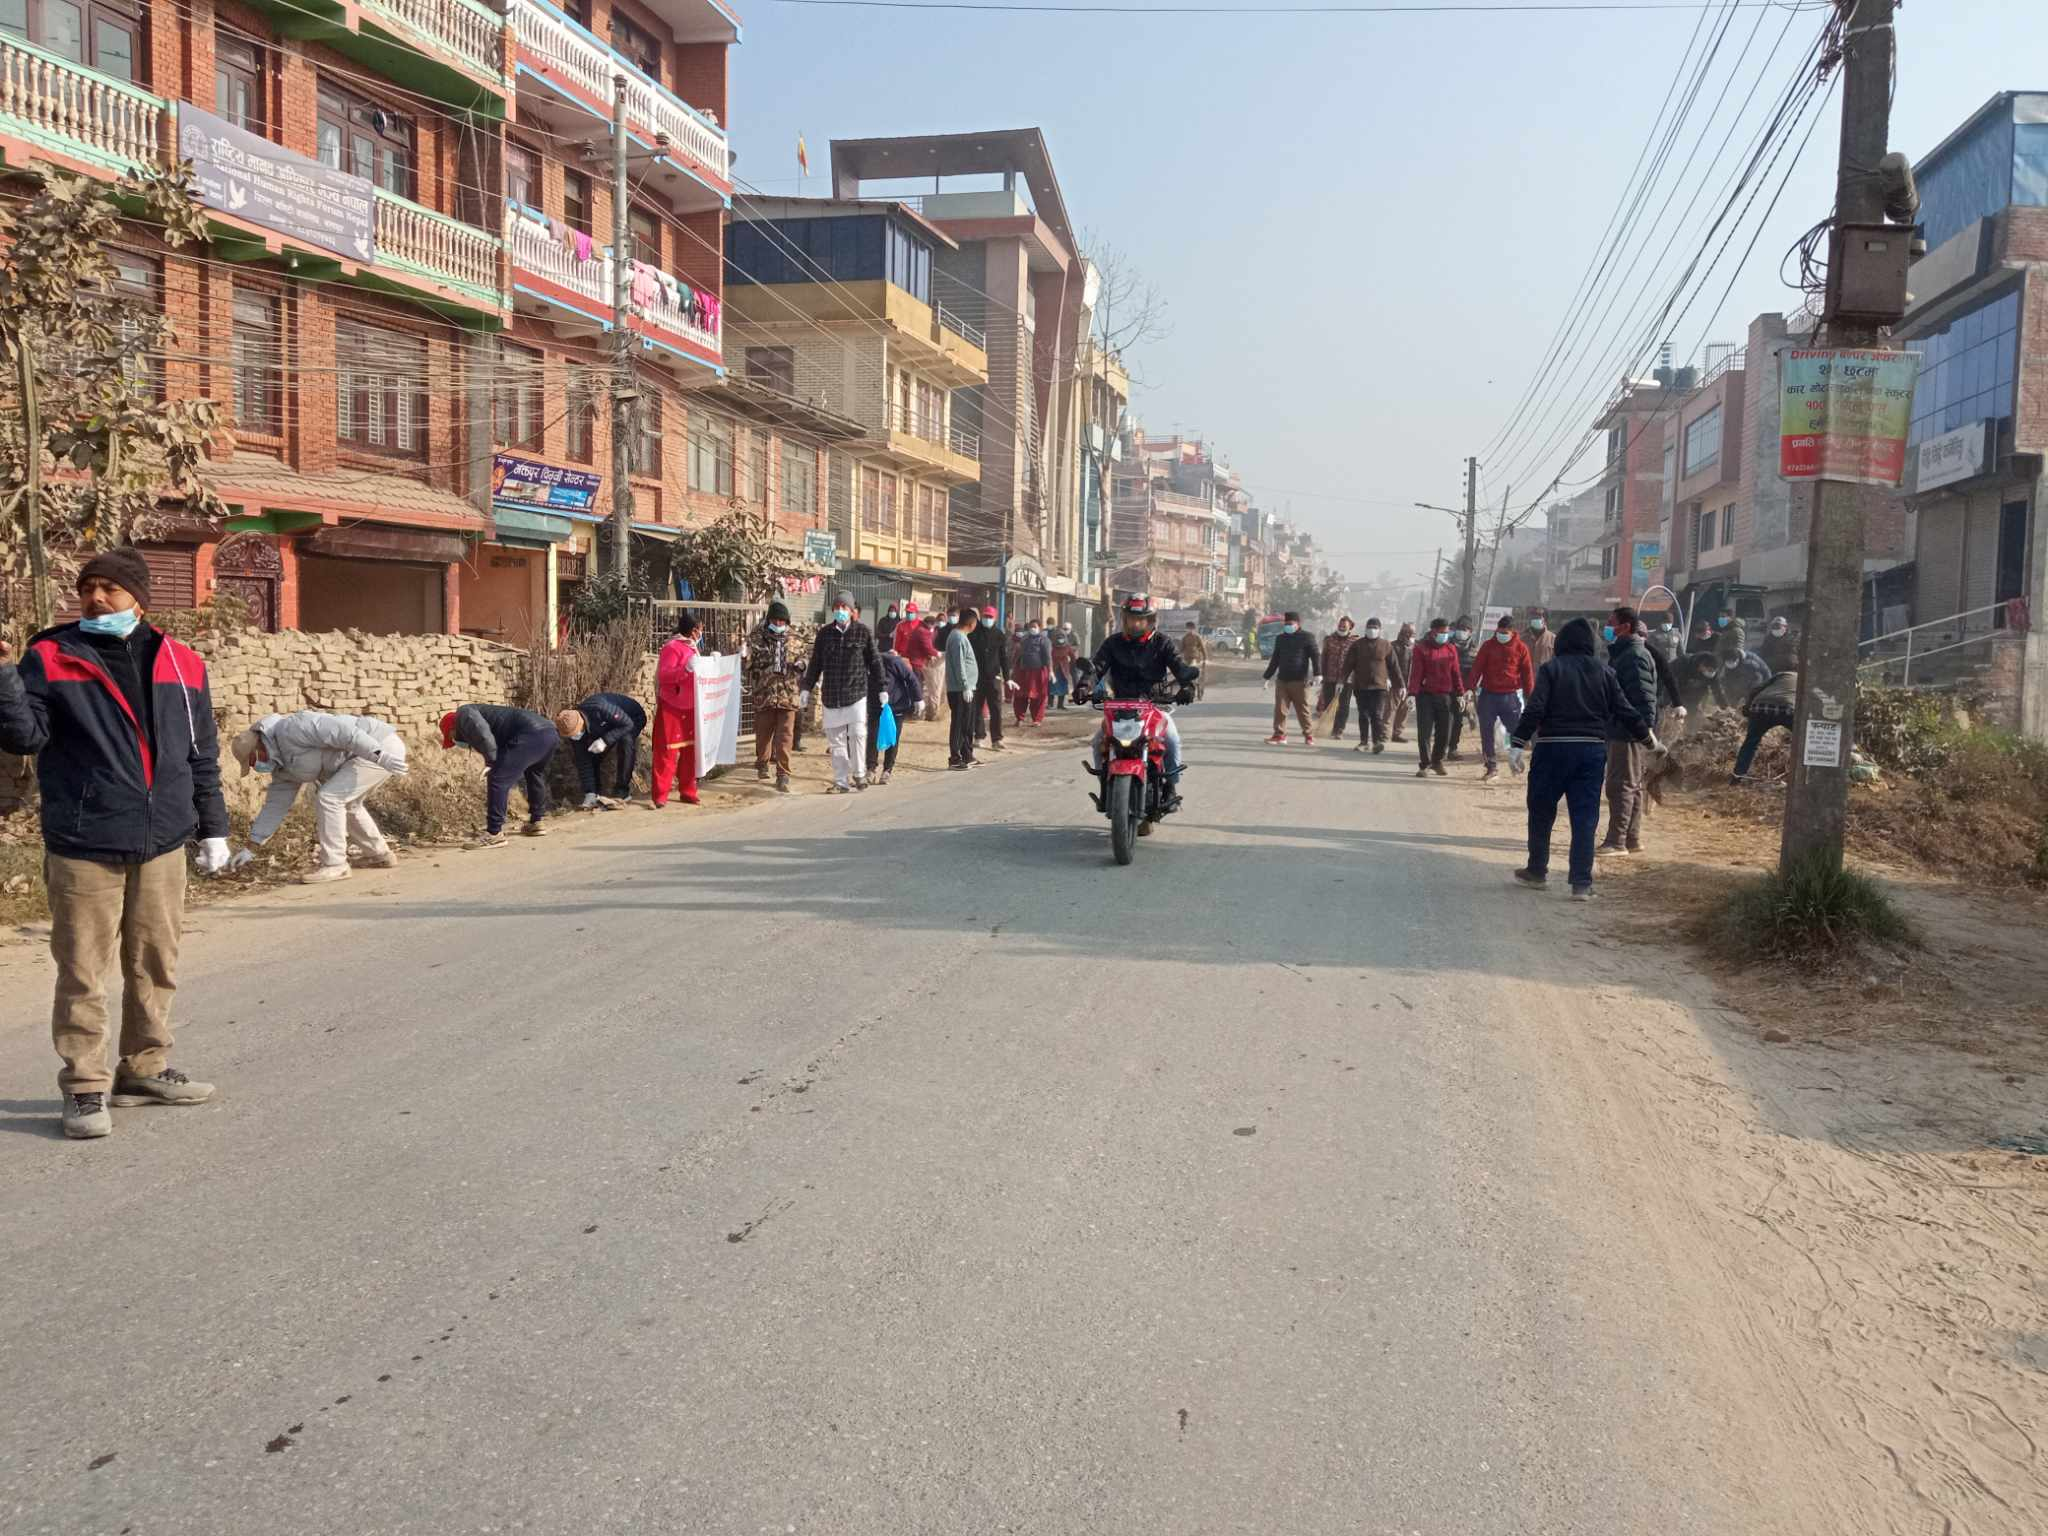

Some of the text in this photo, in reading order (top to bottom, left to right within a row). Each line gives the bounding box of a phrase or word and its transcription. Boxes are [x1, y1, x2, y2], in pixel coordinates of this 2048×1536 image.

[212, 158, 369, 228] National Human Rights Forum Nepal
